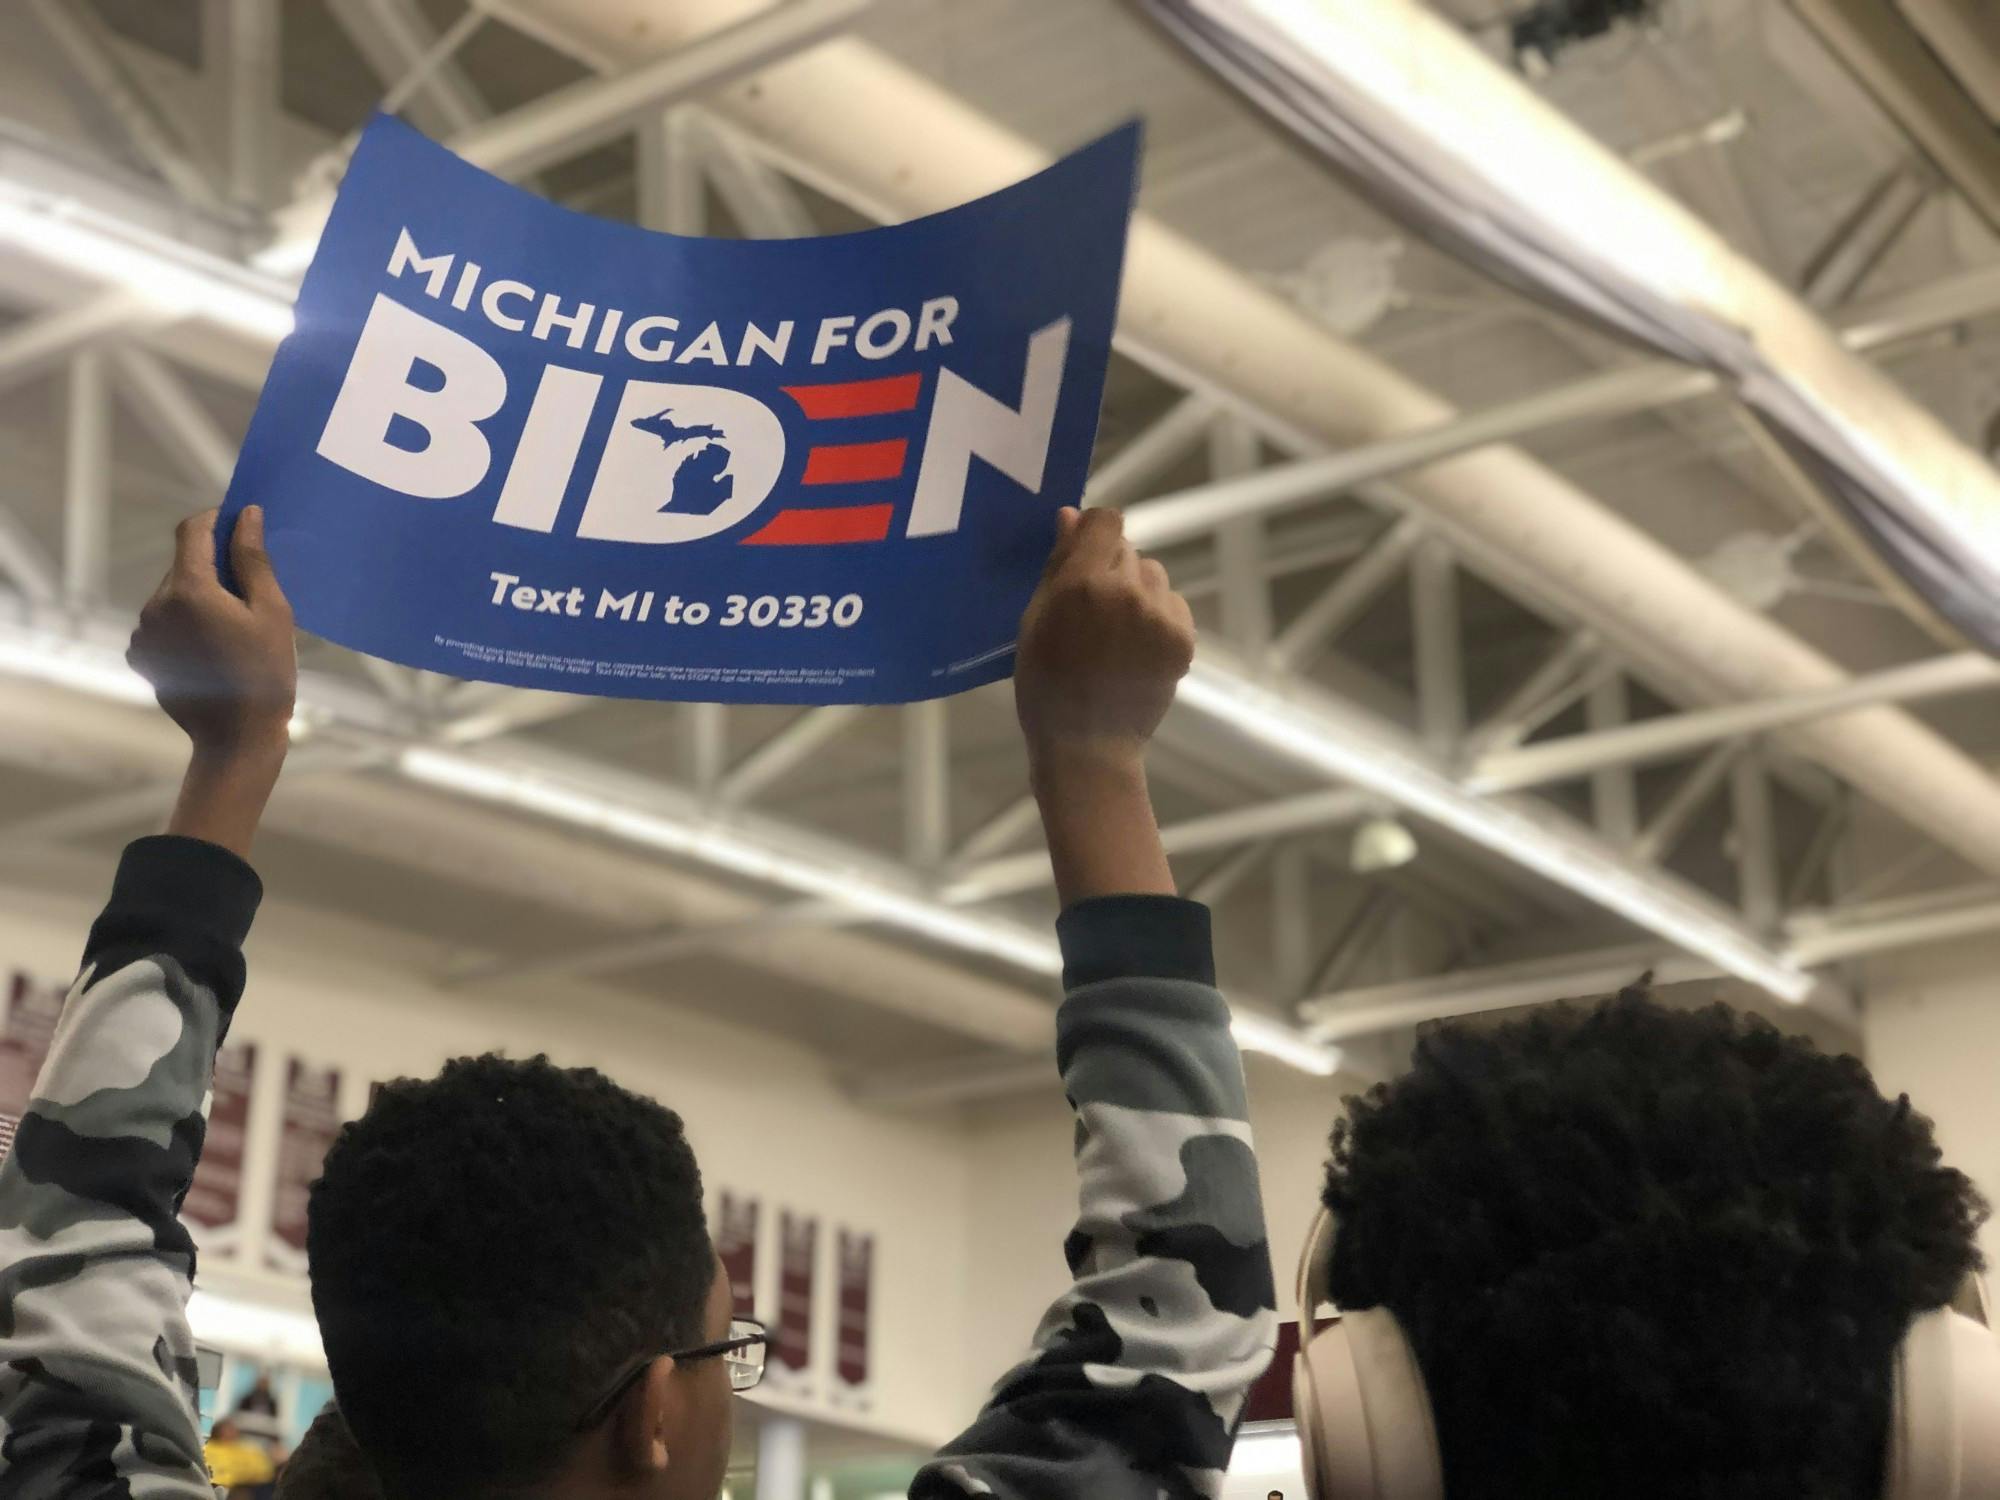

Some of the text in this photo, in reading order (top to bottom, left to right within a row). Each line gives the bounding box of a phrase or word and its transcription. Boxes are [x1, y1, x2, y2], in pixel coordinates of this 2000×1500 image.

[386, 226, 959, 366] MICHIGAN FOR
[316, 292, 1073, 546] BIDEN
[490, 572, 863, 628] Text MI to 30330
